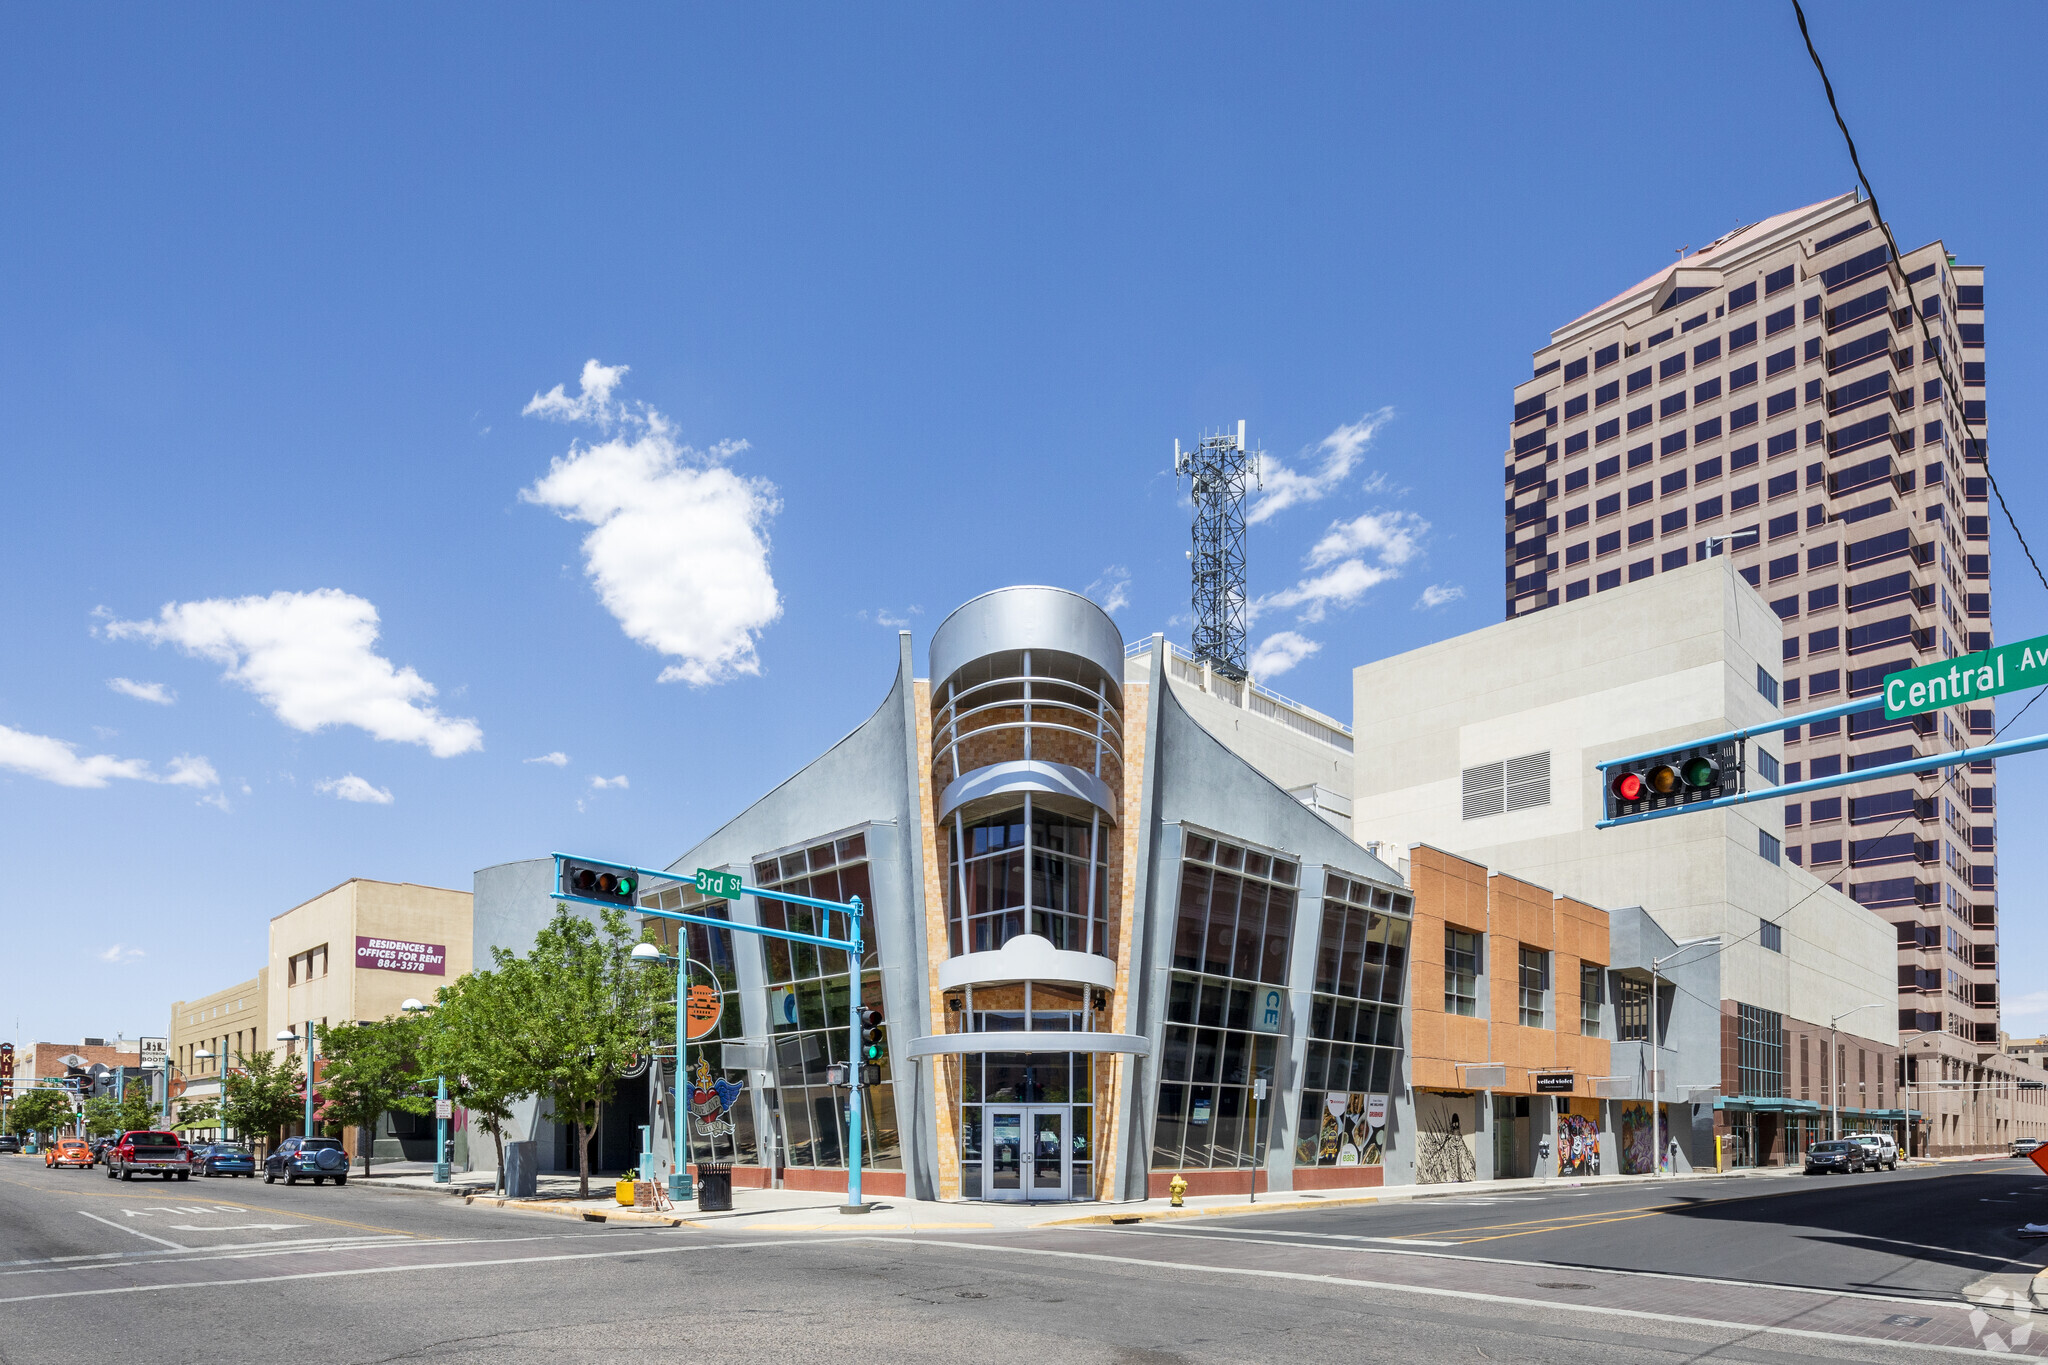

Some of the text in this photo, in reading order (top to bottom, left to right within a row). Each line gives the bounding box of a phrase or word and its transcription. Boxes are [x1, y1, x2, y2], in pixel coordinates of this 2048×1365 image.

[1886, 646, 2048, 712] Central Av
[697, 871, 741, 893] 3rd St
[368, 939, 434, 954] RESIDENCES &
[357, 947, 443, 964] OFFICES FOR RENT
[377, 958, 425, 972] 884-3578
[1342, 1154, 1355, 1162] eats
[120, 1206, 247, 1217] ONLY
